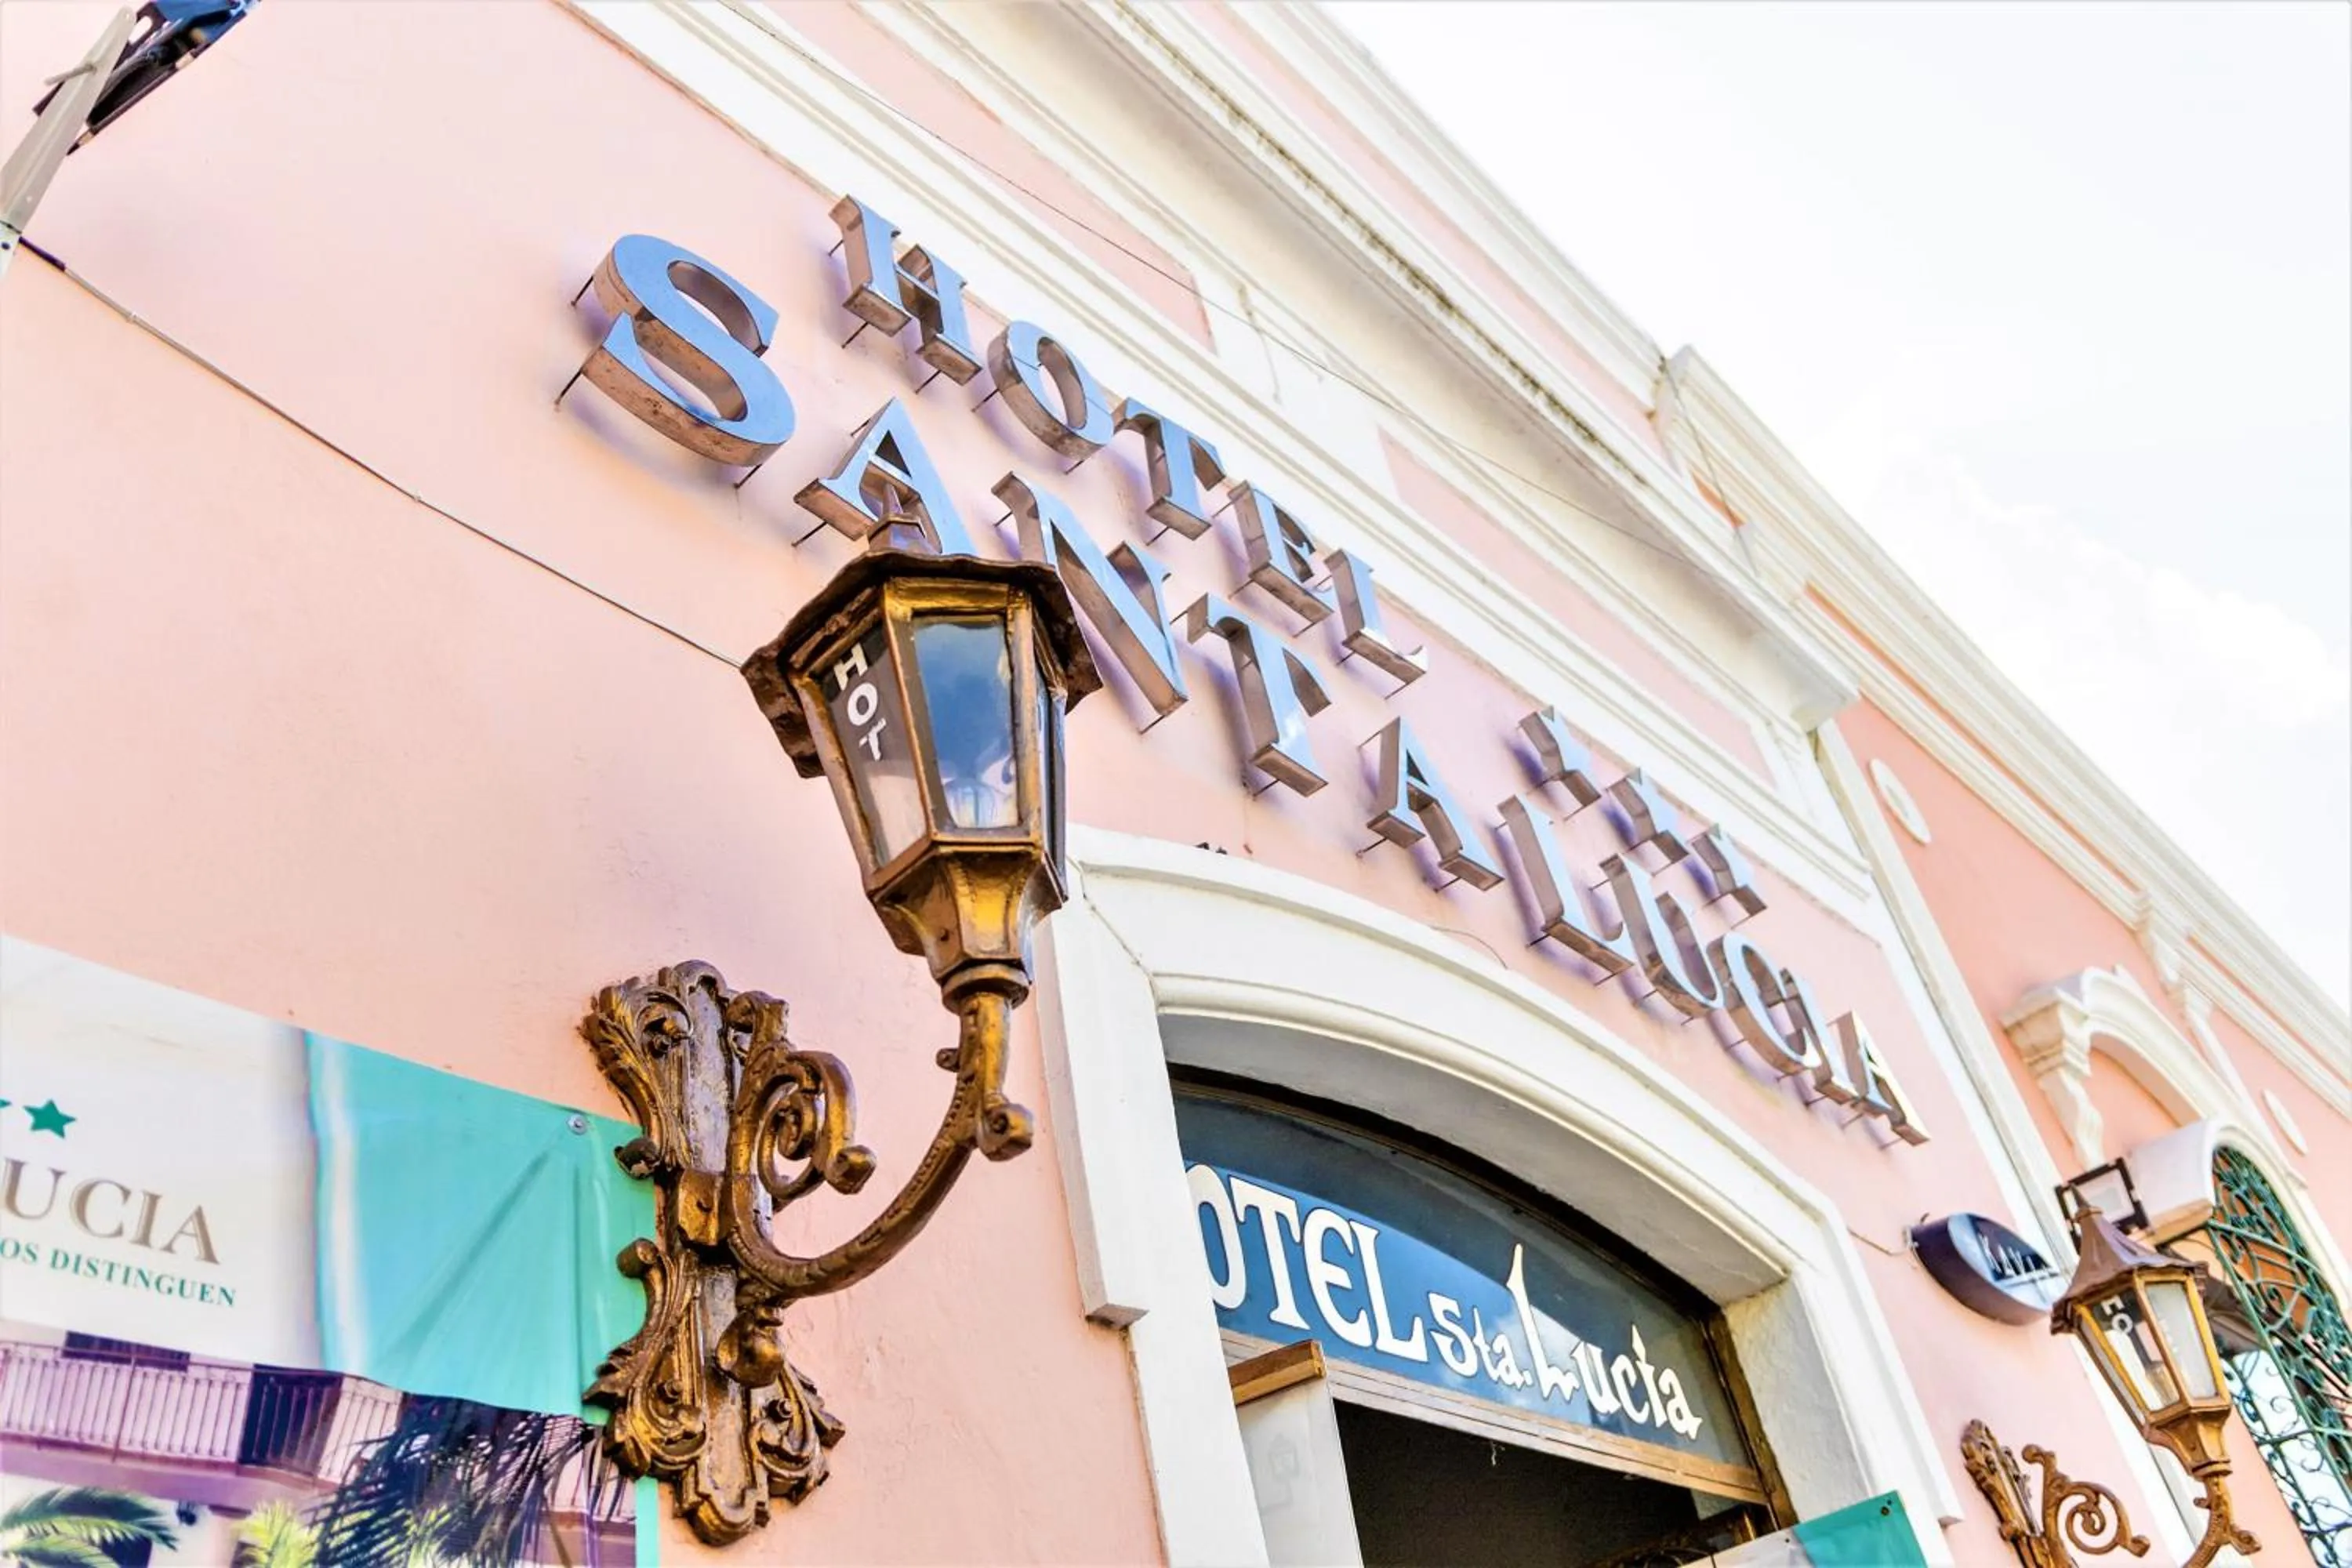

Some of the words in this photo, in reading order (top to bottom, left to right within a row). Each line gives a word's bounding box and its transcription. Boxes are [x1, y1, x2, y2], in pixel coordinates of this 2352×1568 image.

[829, 194, 1429, 683] HOTEL
[582, 234, 1504, 891] SANTA
[1497, 793, 1931, 1146] LUCIA
[3, 1156, 220, 1265] UCIA
[49, 1247, 237, 1308] DISTINGUEN
